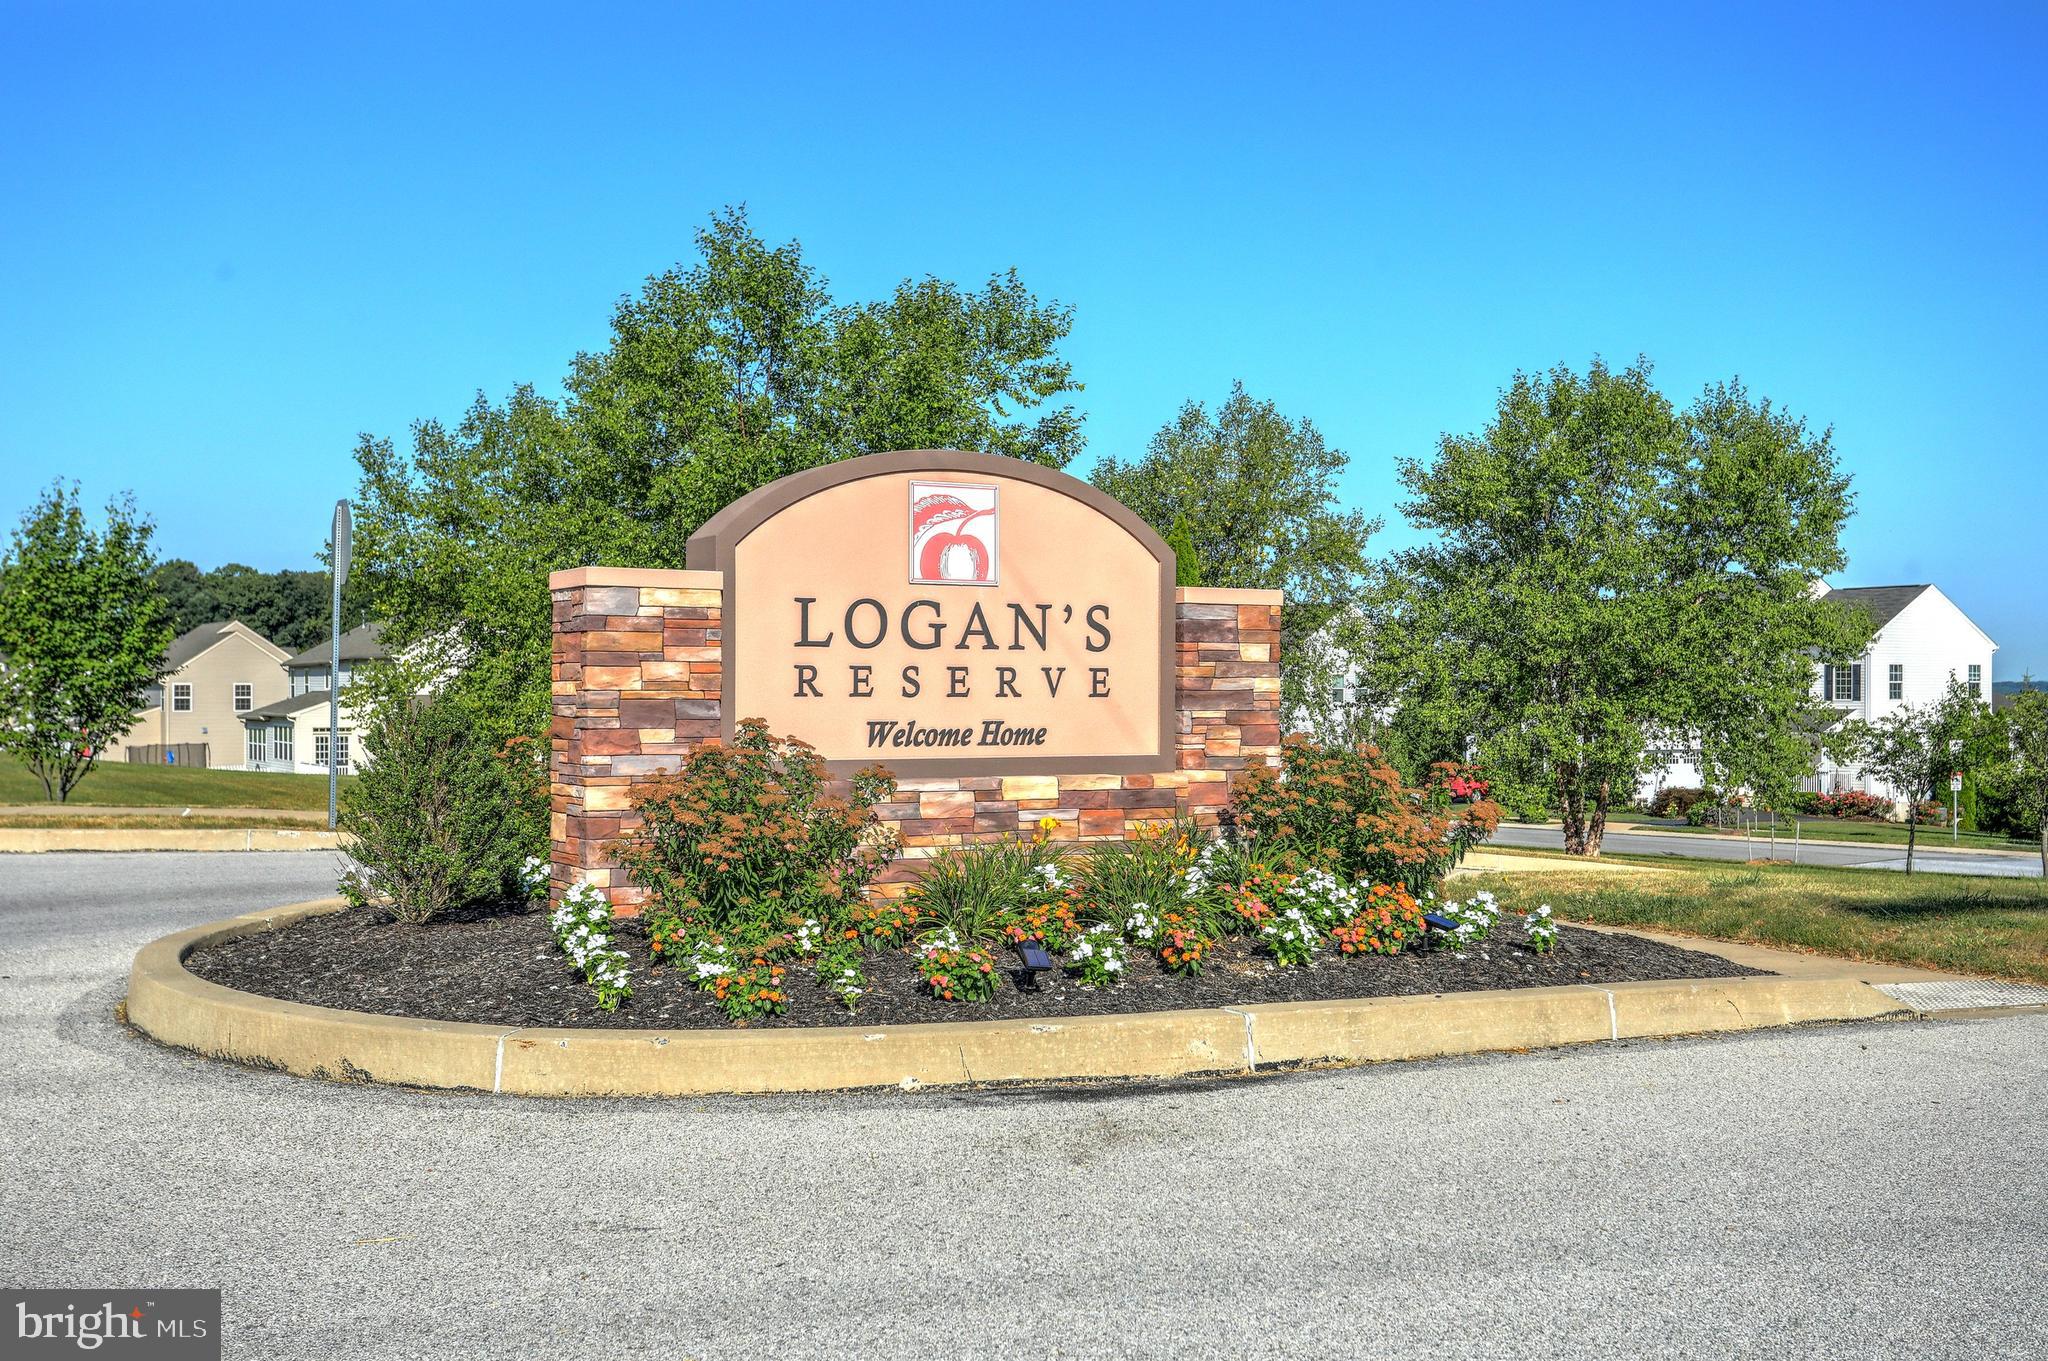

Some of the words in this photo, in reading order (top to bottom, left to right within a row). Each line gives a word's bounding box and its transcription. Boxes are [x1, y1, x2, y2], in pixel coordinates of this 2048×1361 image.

[794, 597, 1111, 653] LOGAN'S
[793, 664, 1112, 699] RESERVE
[866, 720, 974, 748] Welcome
[977, 720, 1048, 747] Home
